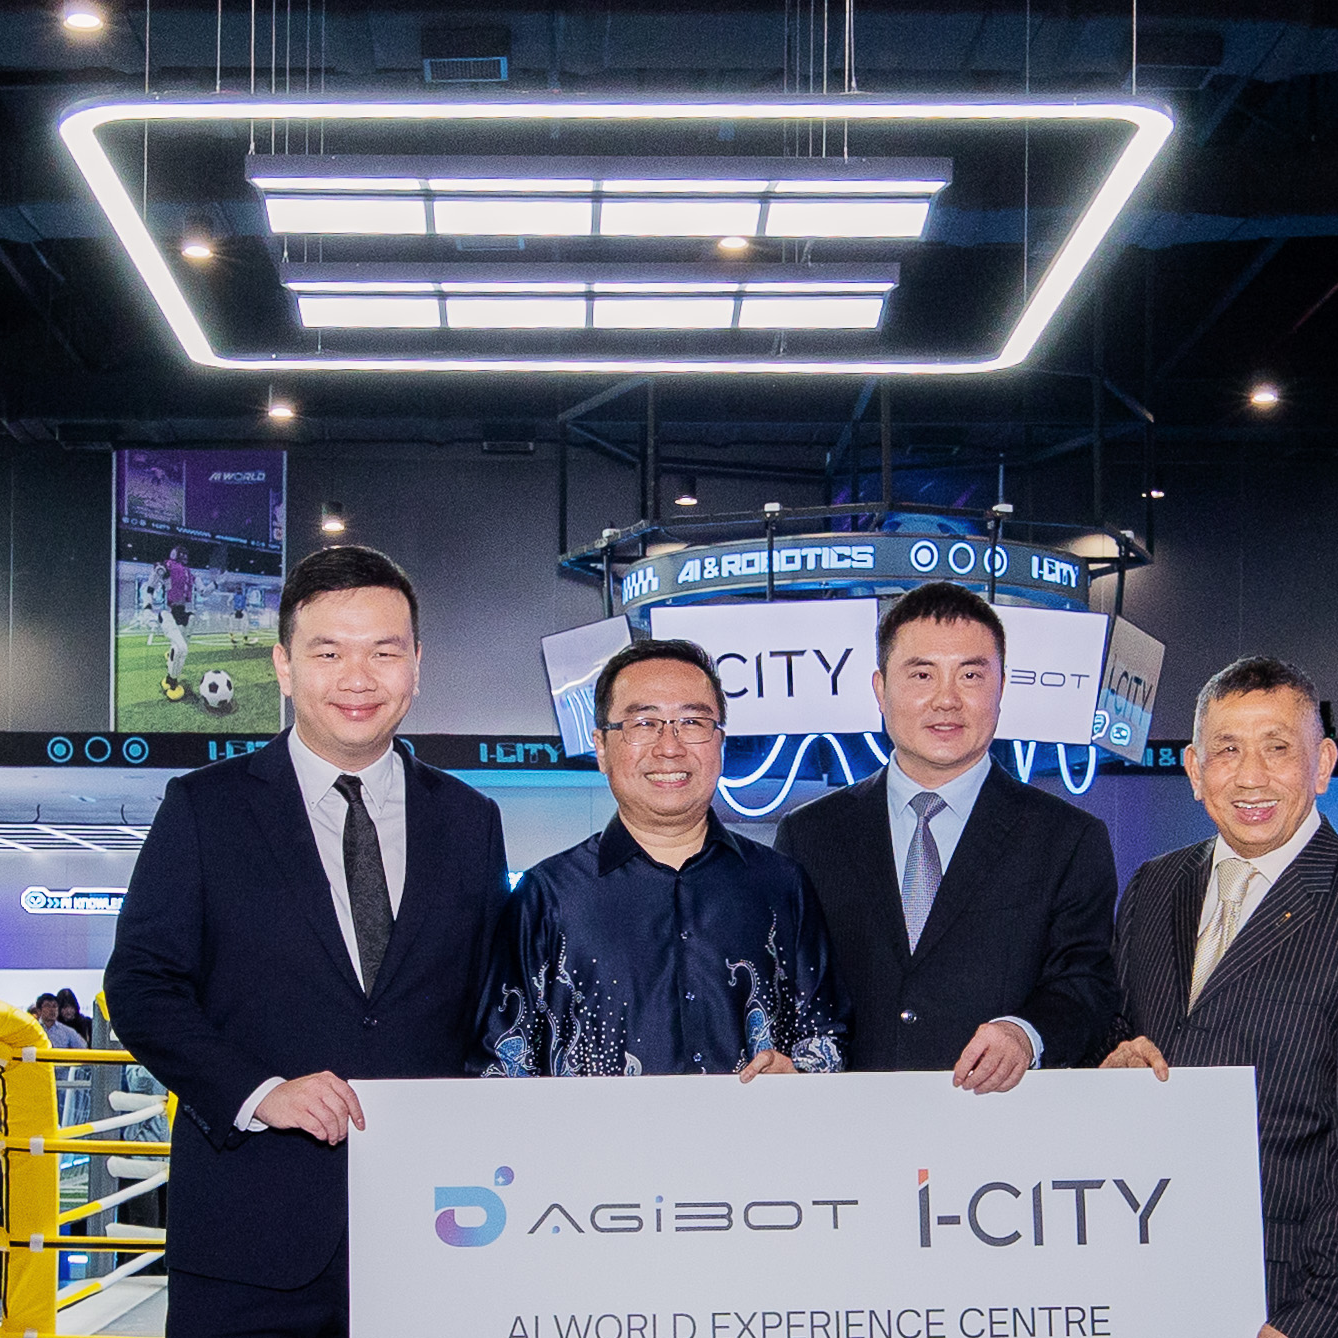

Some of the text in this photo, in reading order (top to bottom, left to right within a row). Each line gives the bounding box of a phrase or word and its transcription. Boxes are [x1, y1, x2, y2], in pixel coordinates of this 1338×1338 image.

[677, 545, 875, 584] AI & ROBOTICS
[716, 648, 854, 698] CITY
[1010, 669, 1090, 689] BOT
[1159, 748, 1176, 767] &
[959, 1305, 1112, 1338] CENTRE
